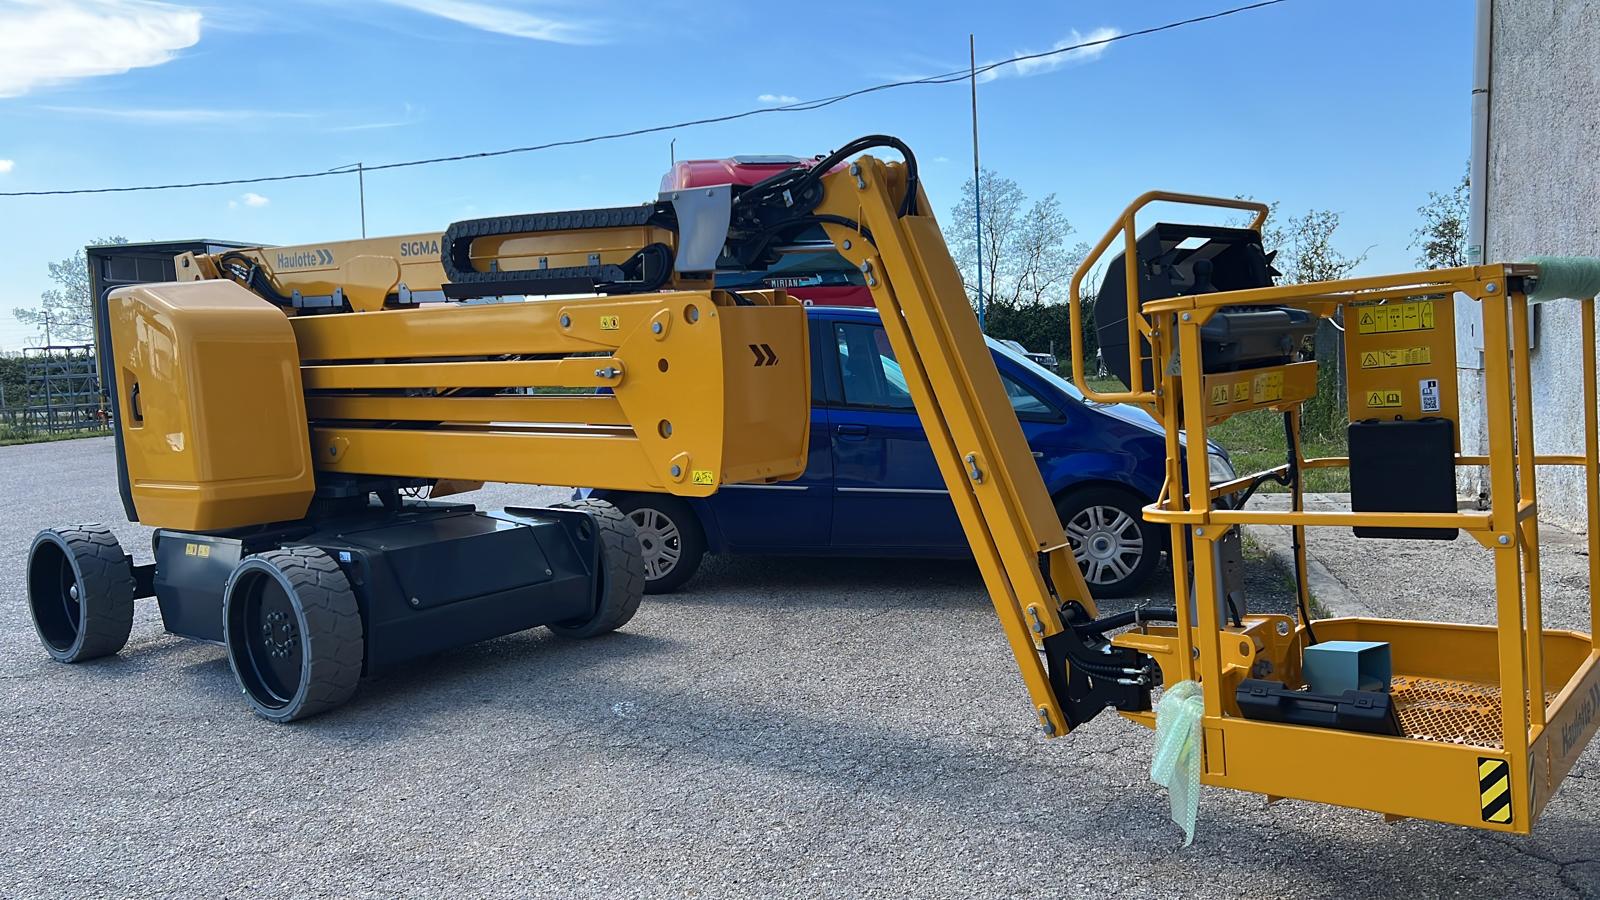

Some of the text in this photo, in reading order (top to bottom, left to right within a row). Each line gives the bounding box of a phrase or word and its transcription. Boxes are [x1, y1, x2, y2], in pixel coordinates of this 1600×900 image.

[400, 240, 439, 257] SIGMA
[277, 252, 316, 268] Haulotte
[771, 279, 801, 288] MIRIAN
